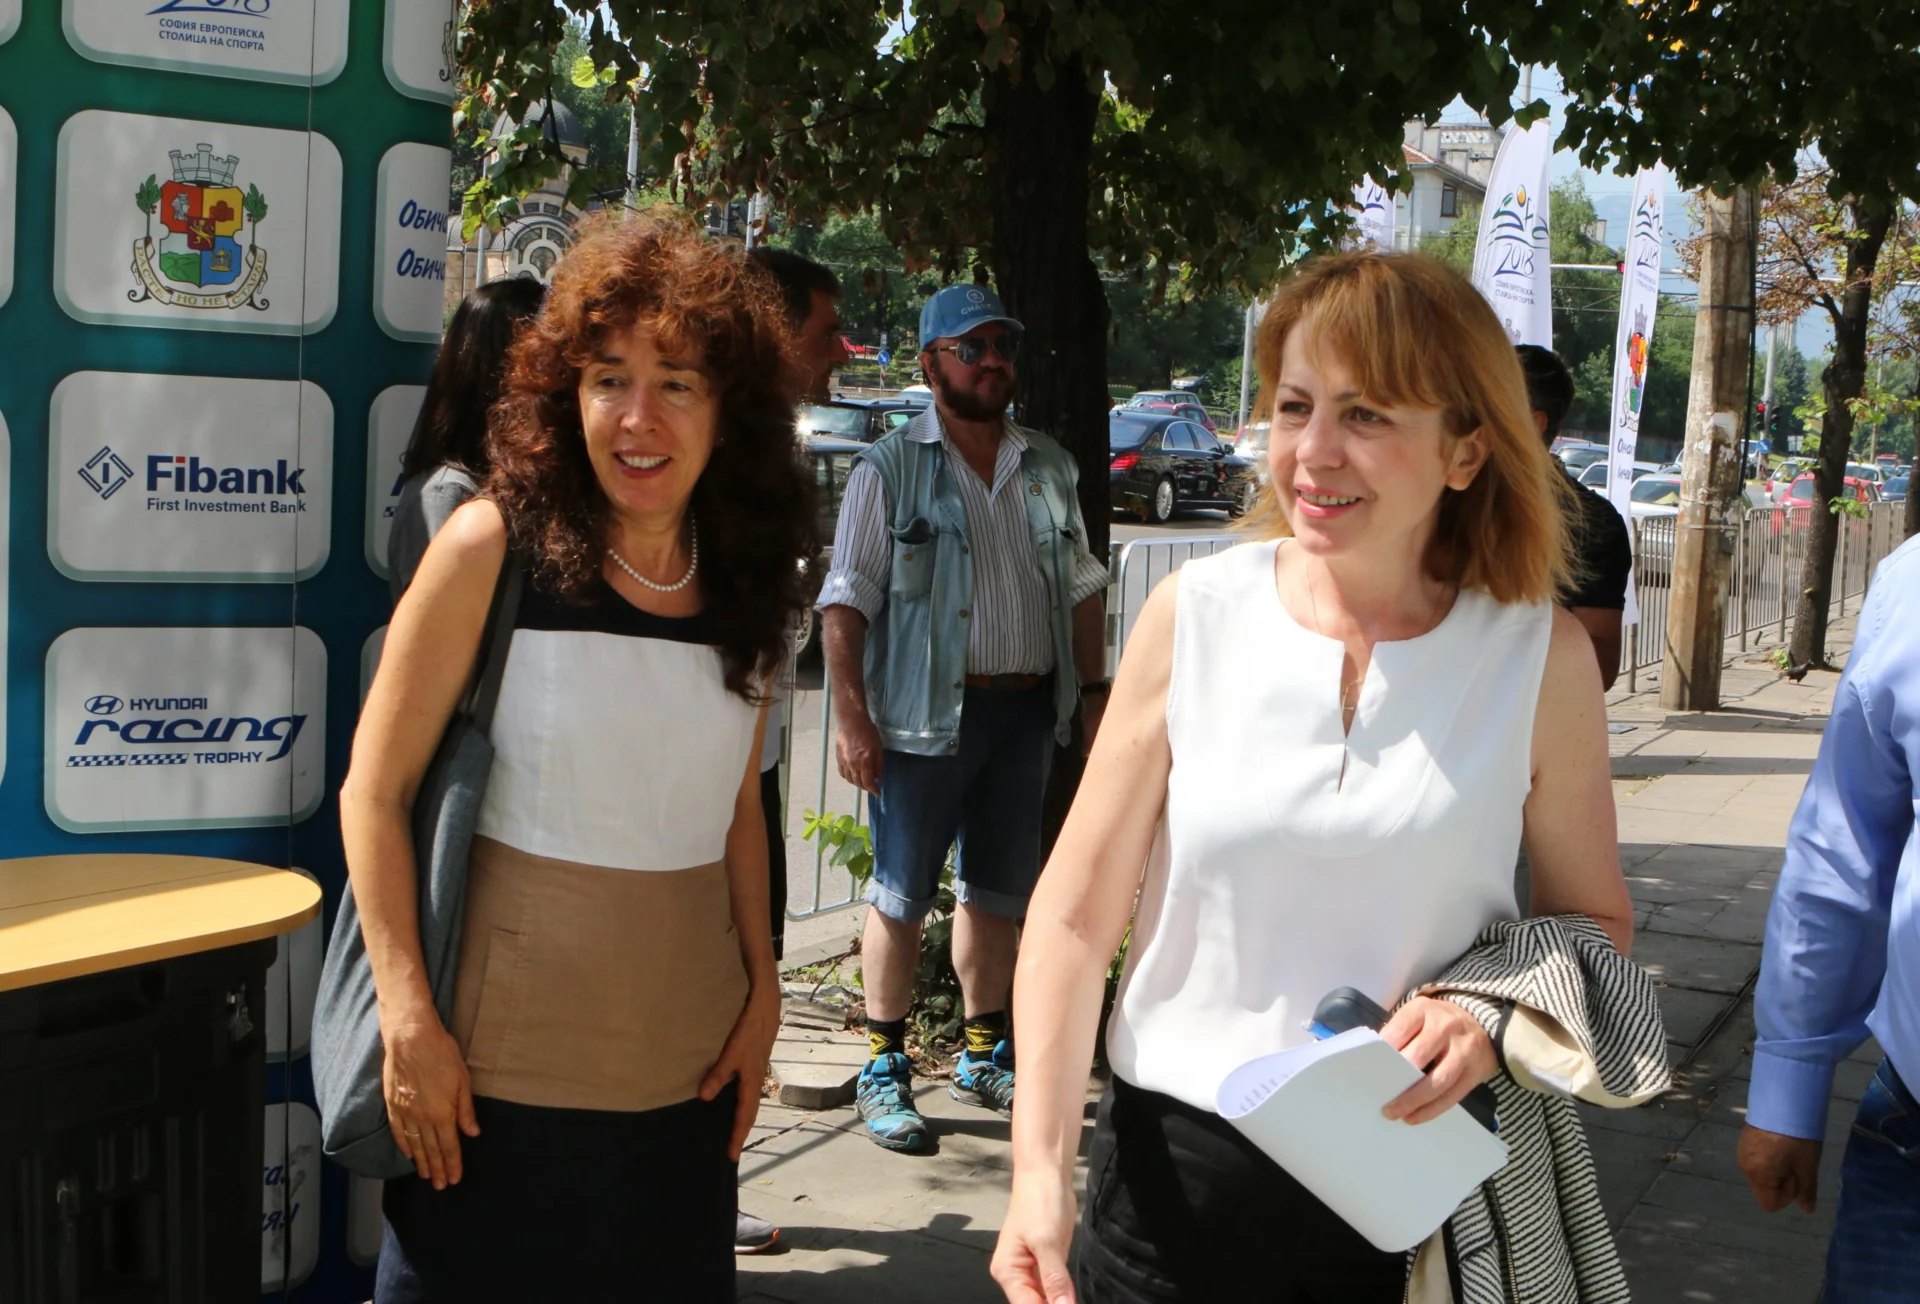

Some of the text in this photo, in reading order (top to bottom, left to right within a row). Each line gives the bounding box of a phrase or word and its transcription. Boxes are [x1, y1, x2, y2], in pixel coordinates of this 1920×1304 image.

[159, 18, 265, 40] СОФИЯ ЕВРОПЕЙСКА
[159, 30, 265, 52] СТОЛИЦА НА СПОРТА
[1492, 243, 1535, 280] 2018
[135, 246, 165, 299] РАСТЕ
[176, 294, 198, 304] НО
[202, 295, 224, 306] НЕ
[146, 454, 307, 495] Fibank
[147, 498, 307, 514] First Investment Bank
[130, 697, 208, 711] HYUNDAI
[74, 714, 308, 762] racing
[194, 751, 263, 764] TROPHY
